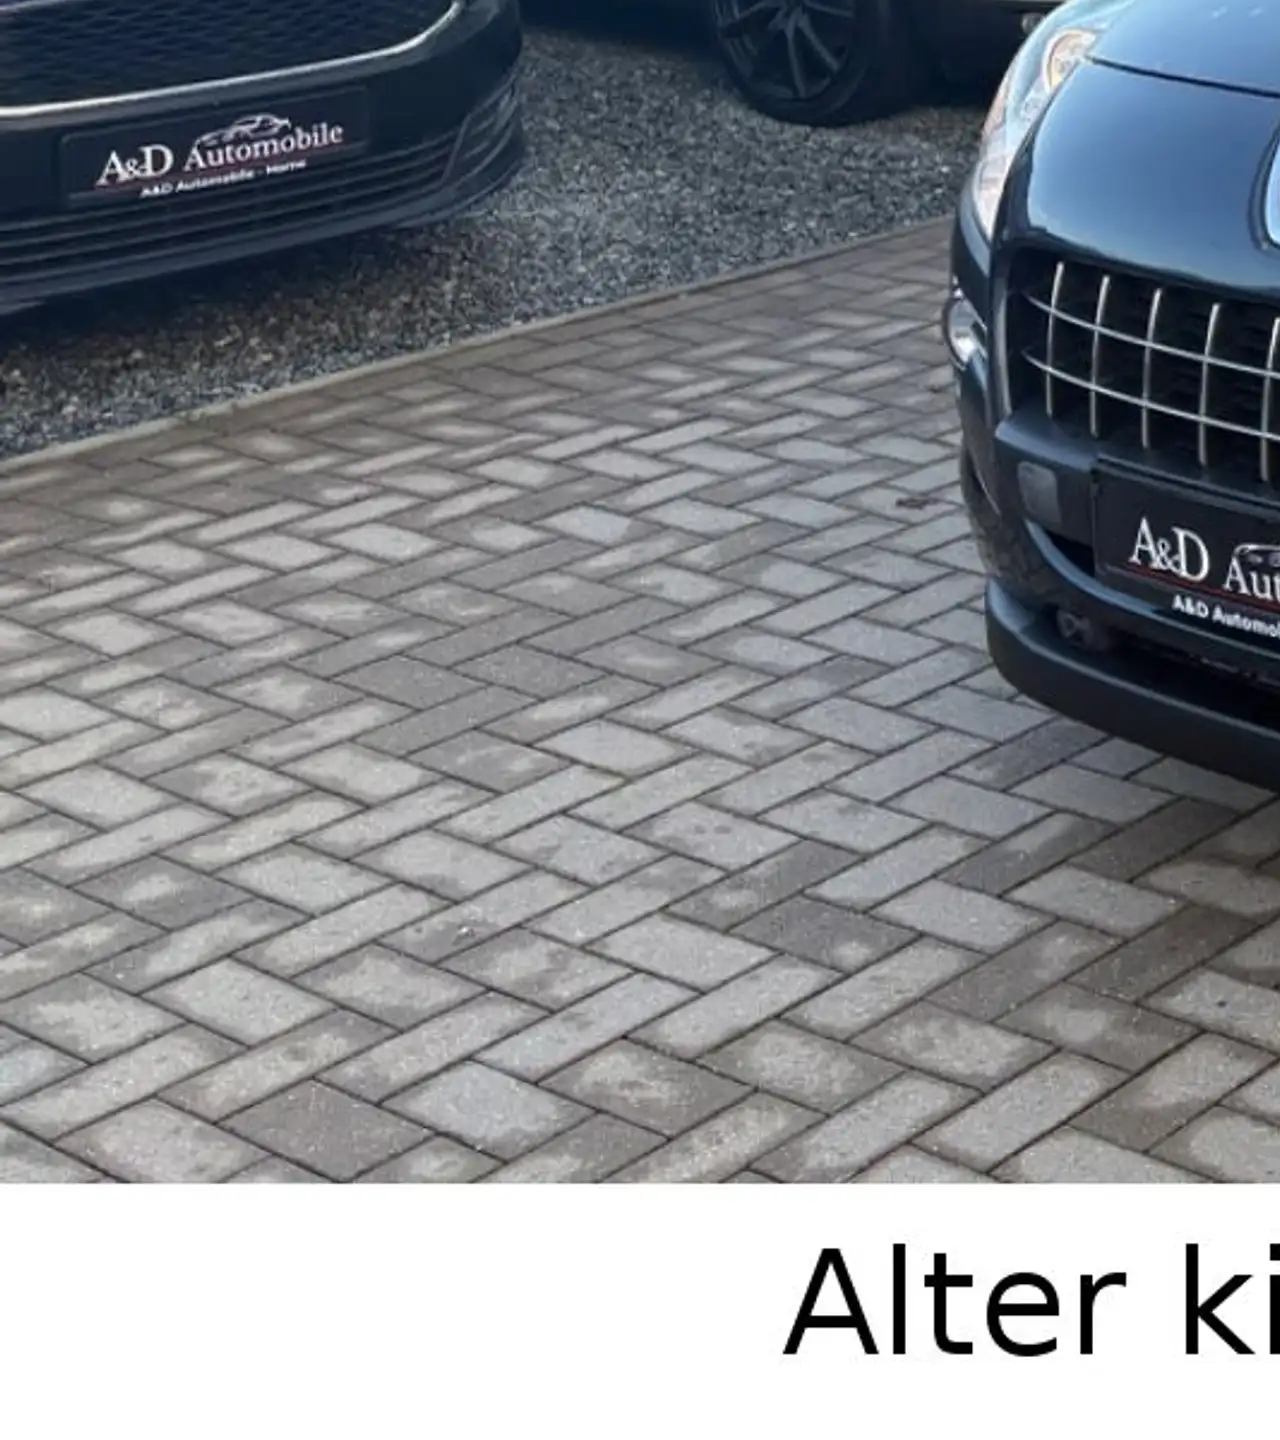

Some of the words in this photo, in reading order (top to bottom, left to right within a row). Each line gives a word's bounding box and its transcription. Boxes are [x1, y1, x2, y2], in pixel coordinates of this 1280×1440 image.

[96, 144, 174, 186] A&D
[183, 122, 343, 172] Automobile
[1129, 517, 1210, 582] A&D
[1172, 593, 1209, 619] A&D
